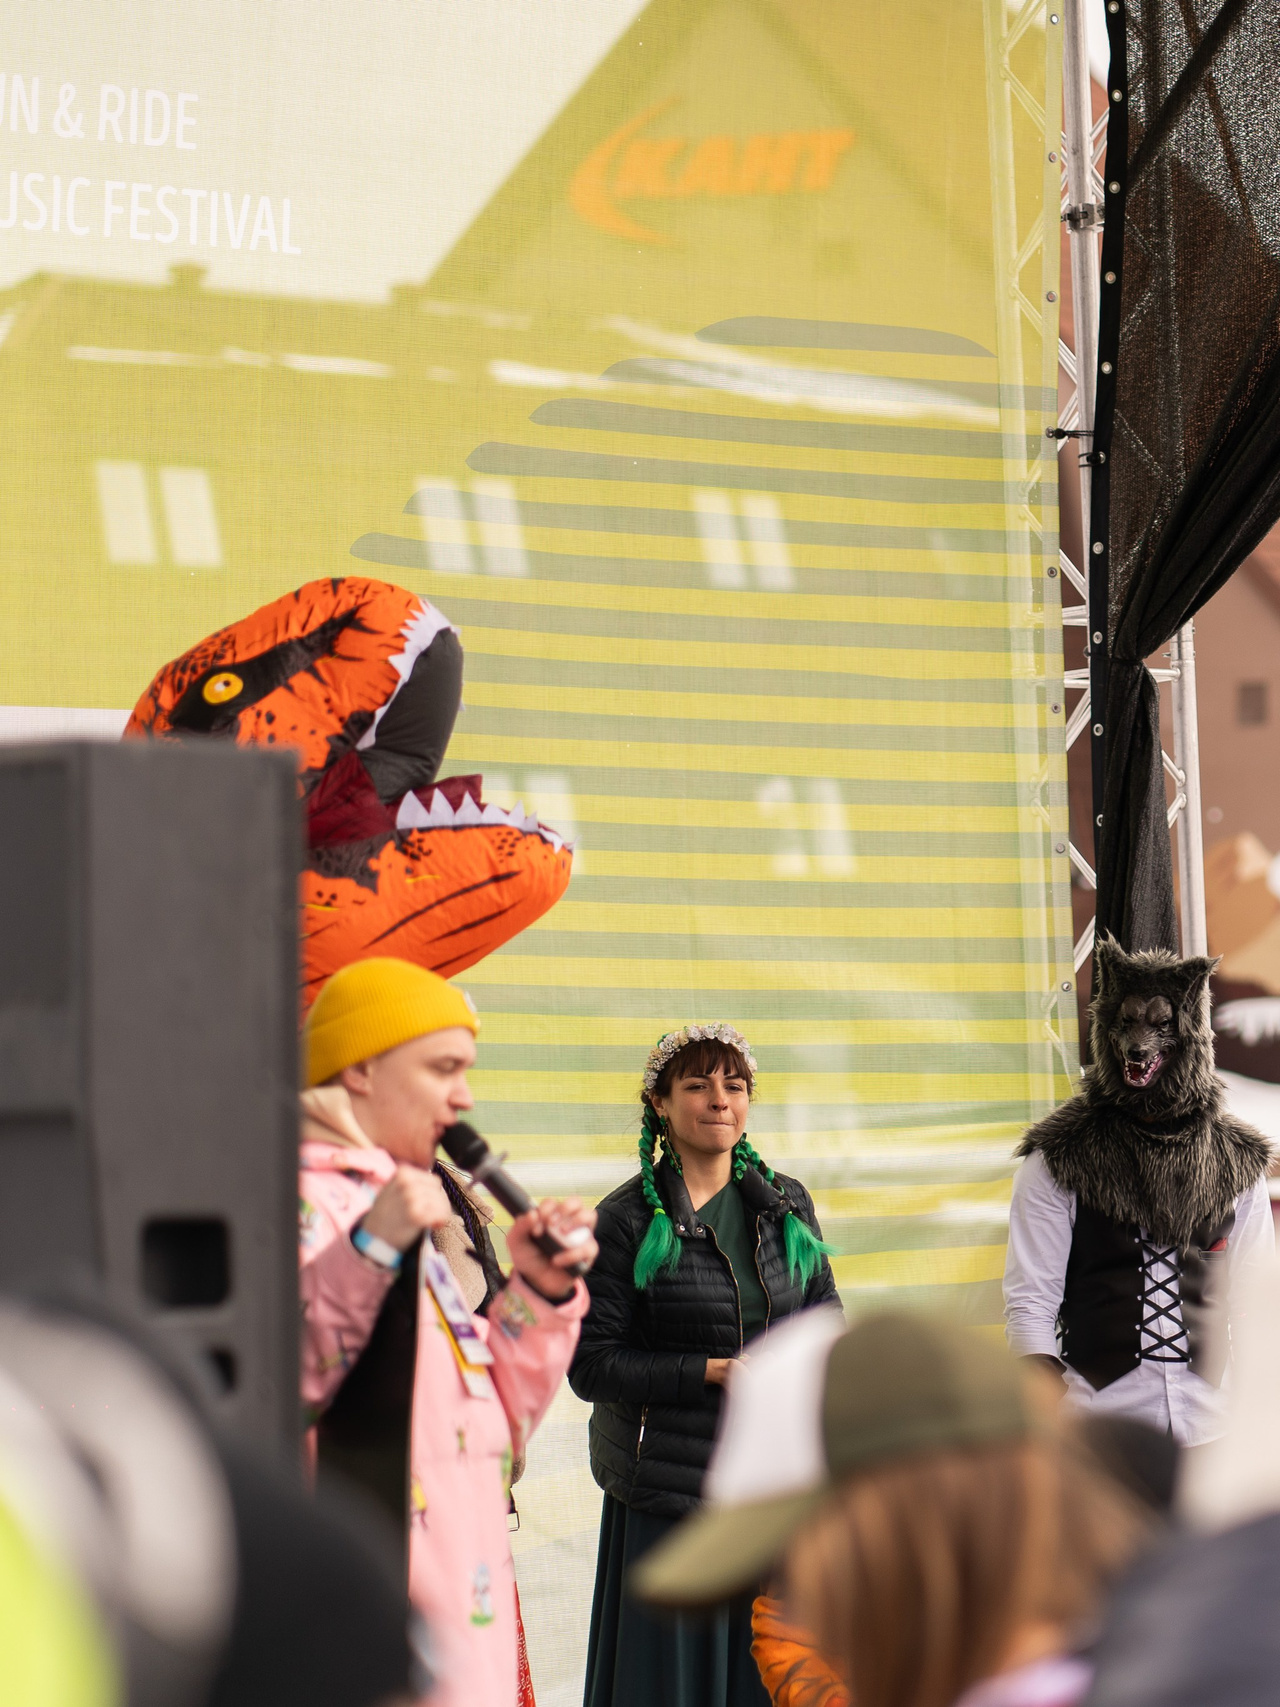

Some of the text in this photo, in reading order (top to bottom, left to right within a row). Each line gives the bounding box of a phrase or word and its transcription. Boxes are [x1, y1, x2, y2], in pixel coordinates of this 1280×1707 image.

[0, 72, 200, 150] N & RIDE
[103, 180, 302, 255] FESTIVAL
